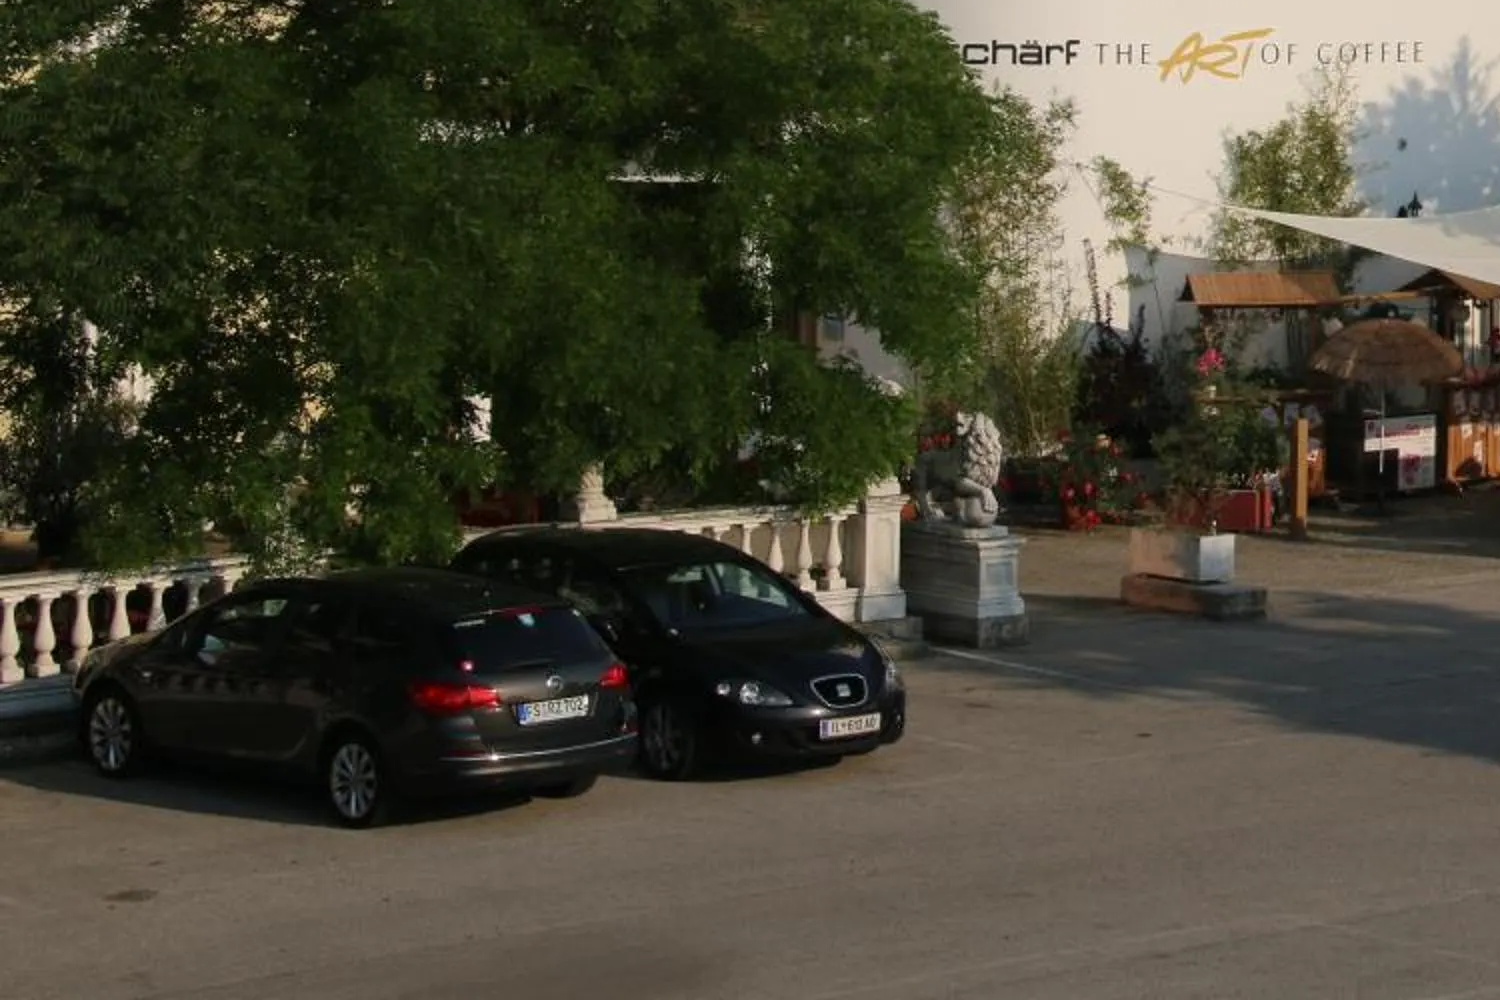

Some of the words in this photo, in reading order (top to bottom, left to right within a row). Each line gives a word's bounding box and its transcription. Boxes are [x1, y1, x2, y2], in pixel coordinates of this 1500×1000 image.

[957, 39, 1080, 65] chärf
[1097, 42, 1151, 64] THE
[1158, 27, 1275, 84] ART
[1260, 42, 1299, 65] OF
[1316, 41, 1425, 65] COFFEE
